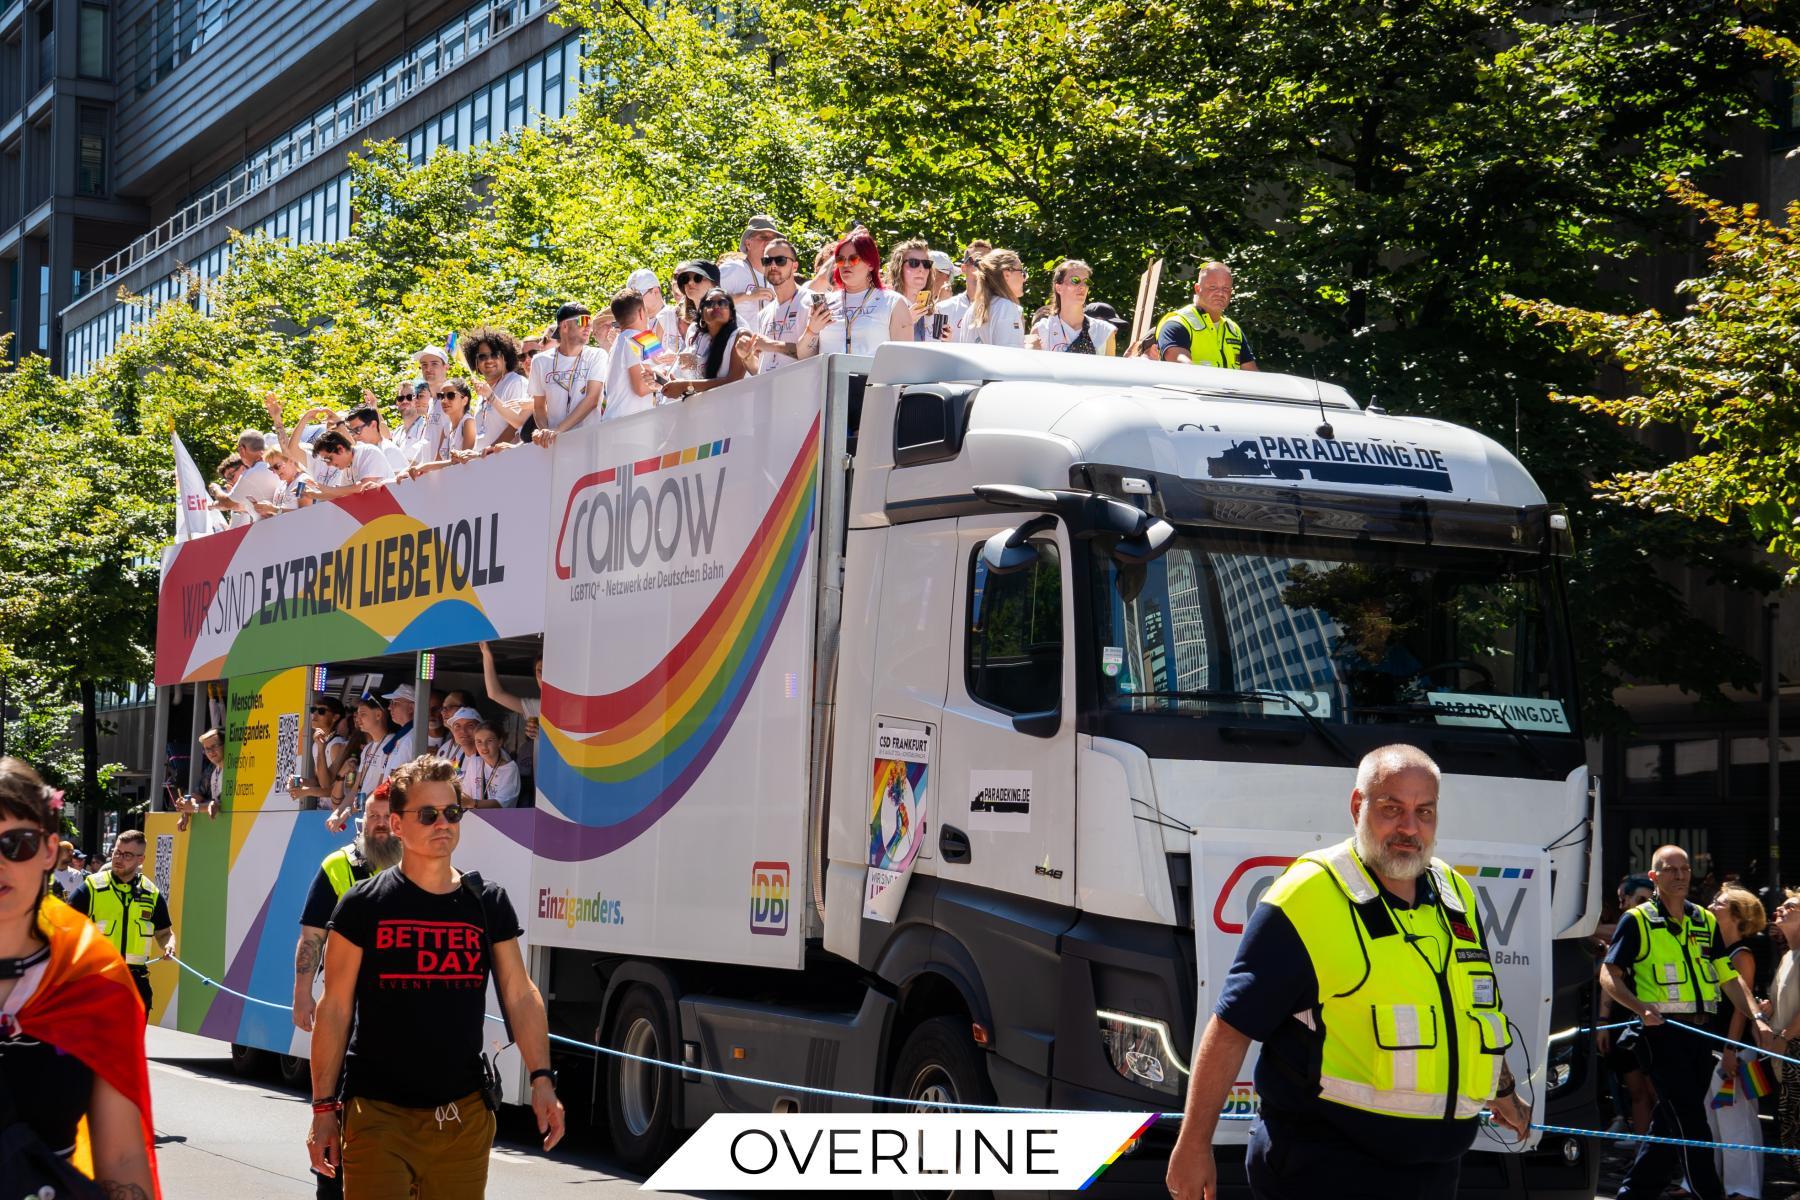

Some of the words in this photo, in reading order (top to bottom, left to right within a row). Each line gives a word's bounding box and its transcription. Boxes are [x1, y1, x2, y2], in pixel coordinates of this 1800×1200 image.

[1259, 436, 1448, 471] PARADEKING.DE
[569, 463, 727, 578] railbow
[182, 580, 211, 638] WIR
[214, 571, 256, 634] SIND
[259, 547, 354, 626] EXTREM
[359, 512, 505, 608] LIEBEVOLL
[606, 573, 642, 596] Netzwerk
[643, 572, 656, 591] der
[657, 565, 700, 589] Deutschen
[702, 560, 724, 581] Bahn
[231, 690, 264, 711] Menschen.
[229, 721, 271, 746] Einziganders.
[879, 736, 891, 748] CSD
[892, 737, 927, 752] FRANKFURT
[984, 788, 1030, 802] PARADEKING.DE
[538, 888, 624, 928] Einziganders.
[754, 873, 785, 924] DB
[376, 926, 481, 950] BETTER
[417, 950, 481, 973] DAY
[1495, 951, 1530, 966] Bahn
[379, 980, 432, 990] EVENT
[445, 980, 482, 990] TEAM
